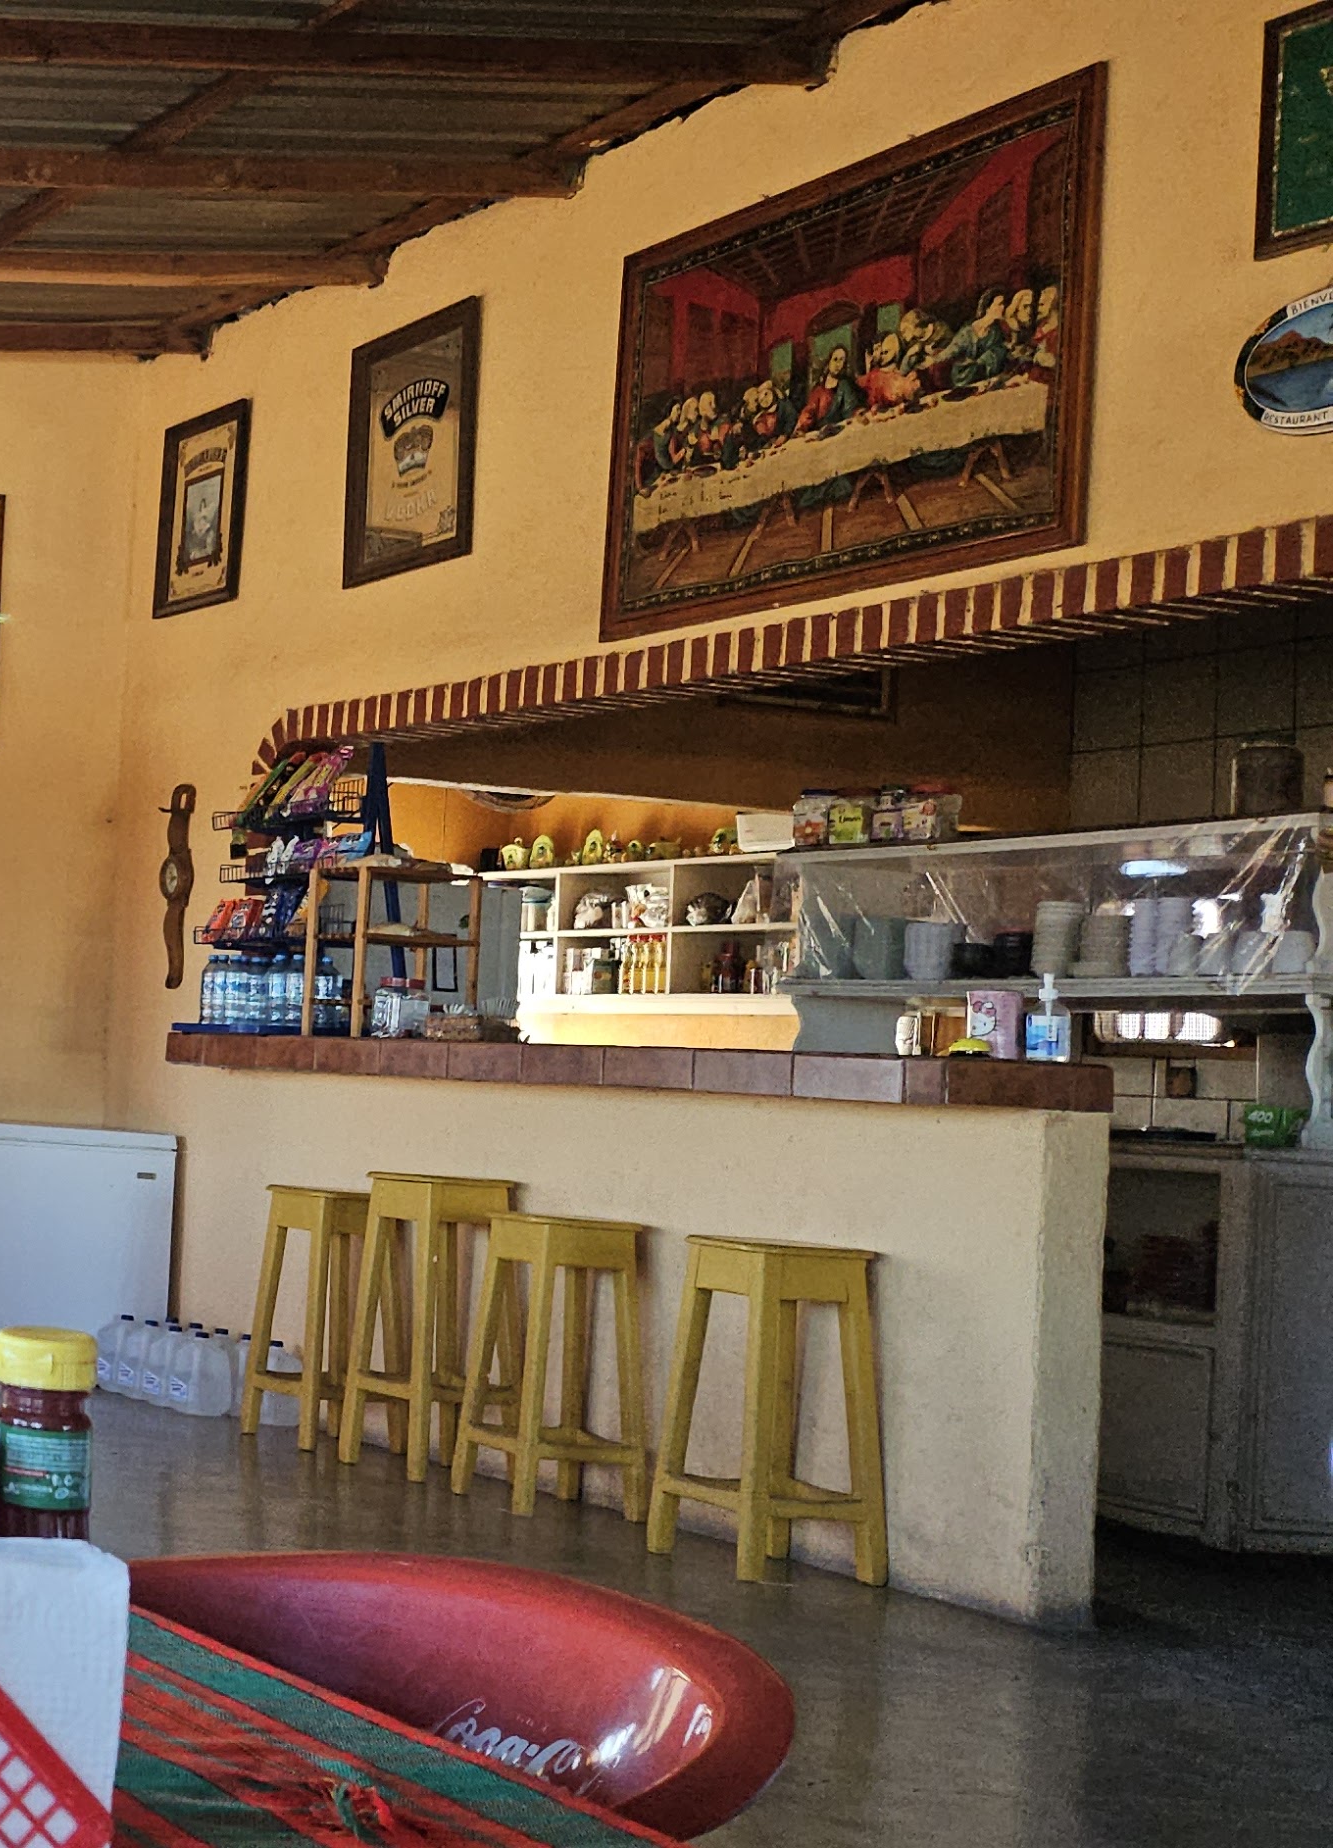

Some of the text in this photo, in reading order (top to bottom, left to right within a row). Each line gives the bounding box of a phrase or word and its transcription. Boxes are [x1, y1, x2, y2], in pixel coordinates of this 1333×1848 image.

[384, 380, 447, 420] SMIRNOFF
[393, 398, 436, 428] SILVER
[1263, 410, 1329, 427] RESTAURANT
